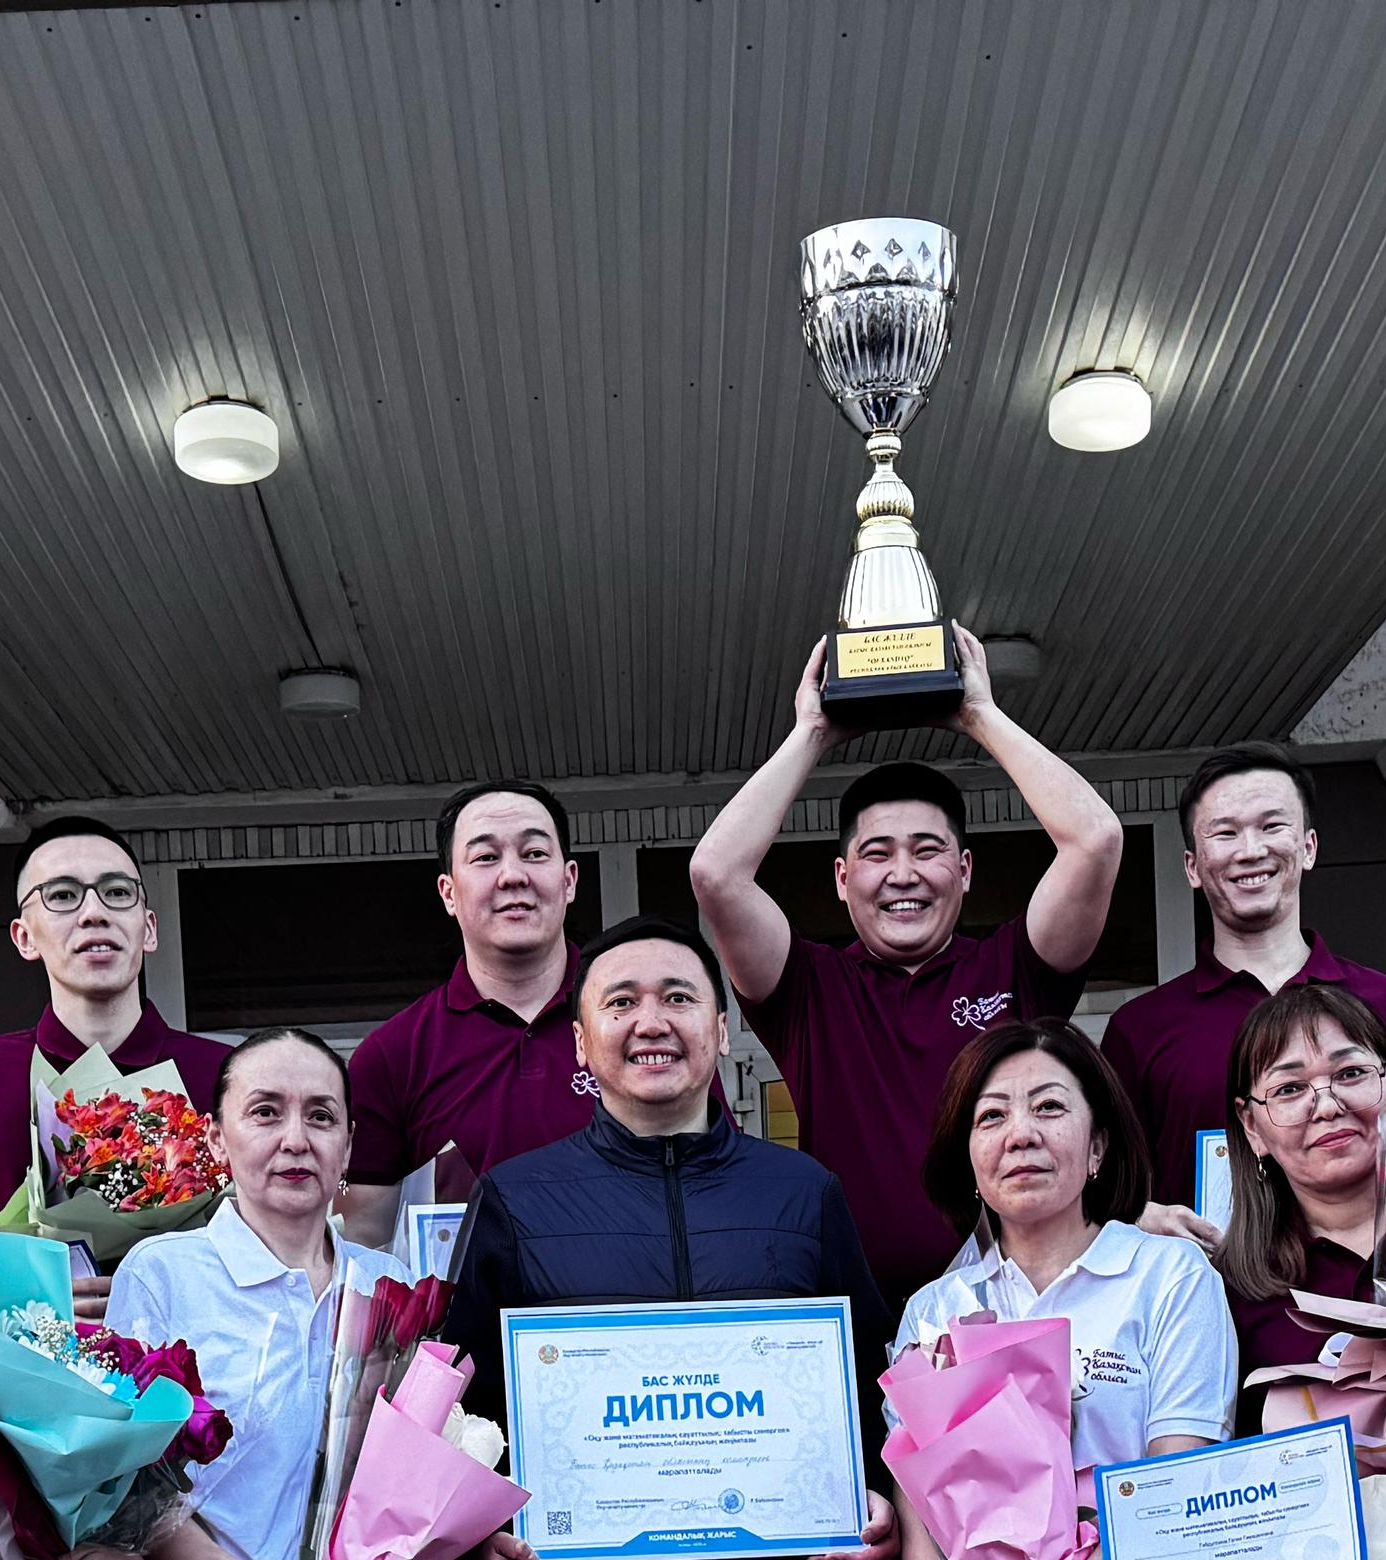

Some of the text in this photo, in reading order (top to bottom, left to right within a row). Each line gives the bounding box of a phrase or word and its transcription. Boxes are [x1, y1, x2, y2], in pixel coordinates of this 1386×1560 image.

[642, 1373, 720, 1388] БАС ЖҮЛДЕ
[602, 1390, 764, 1428] ДИПЛОМ
[1185, 1481, 1277, 1518] ДИПЛОМ
